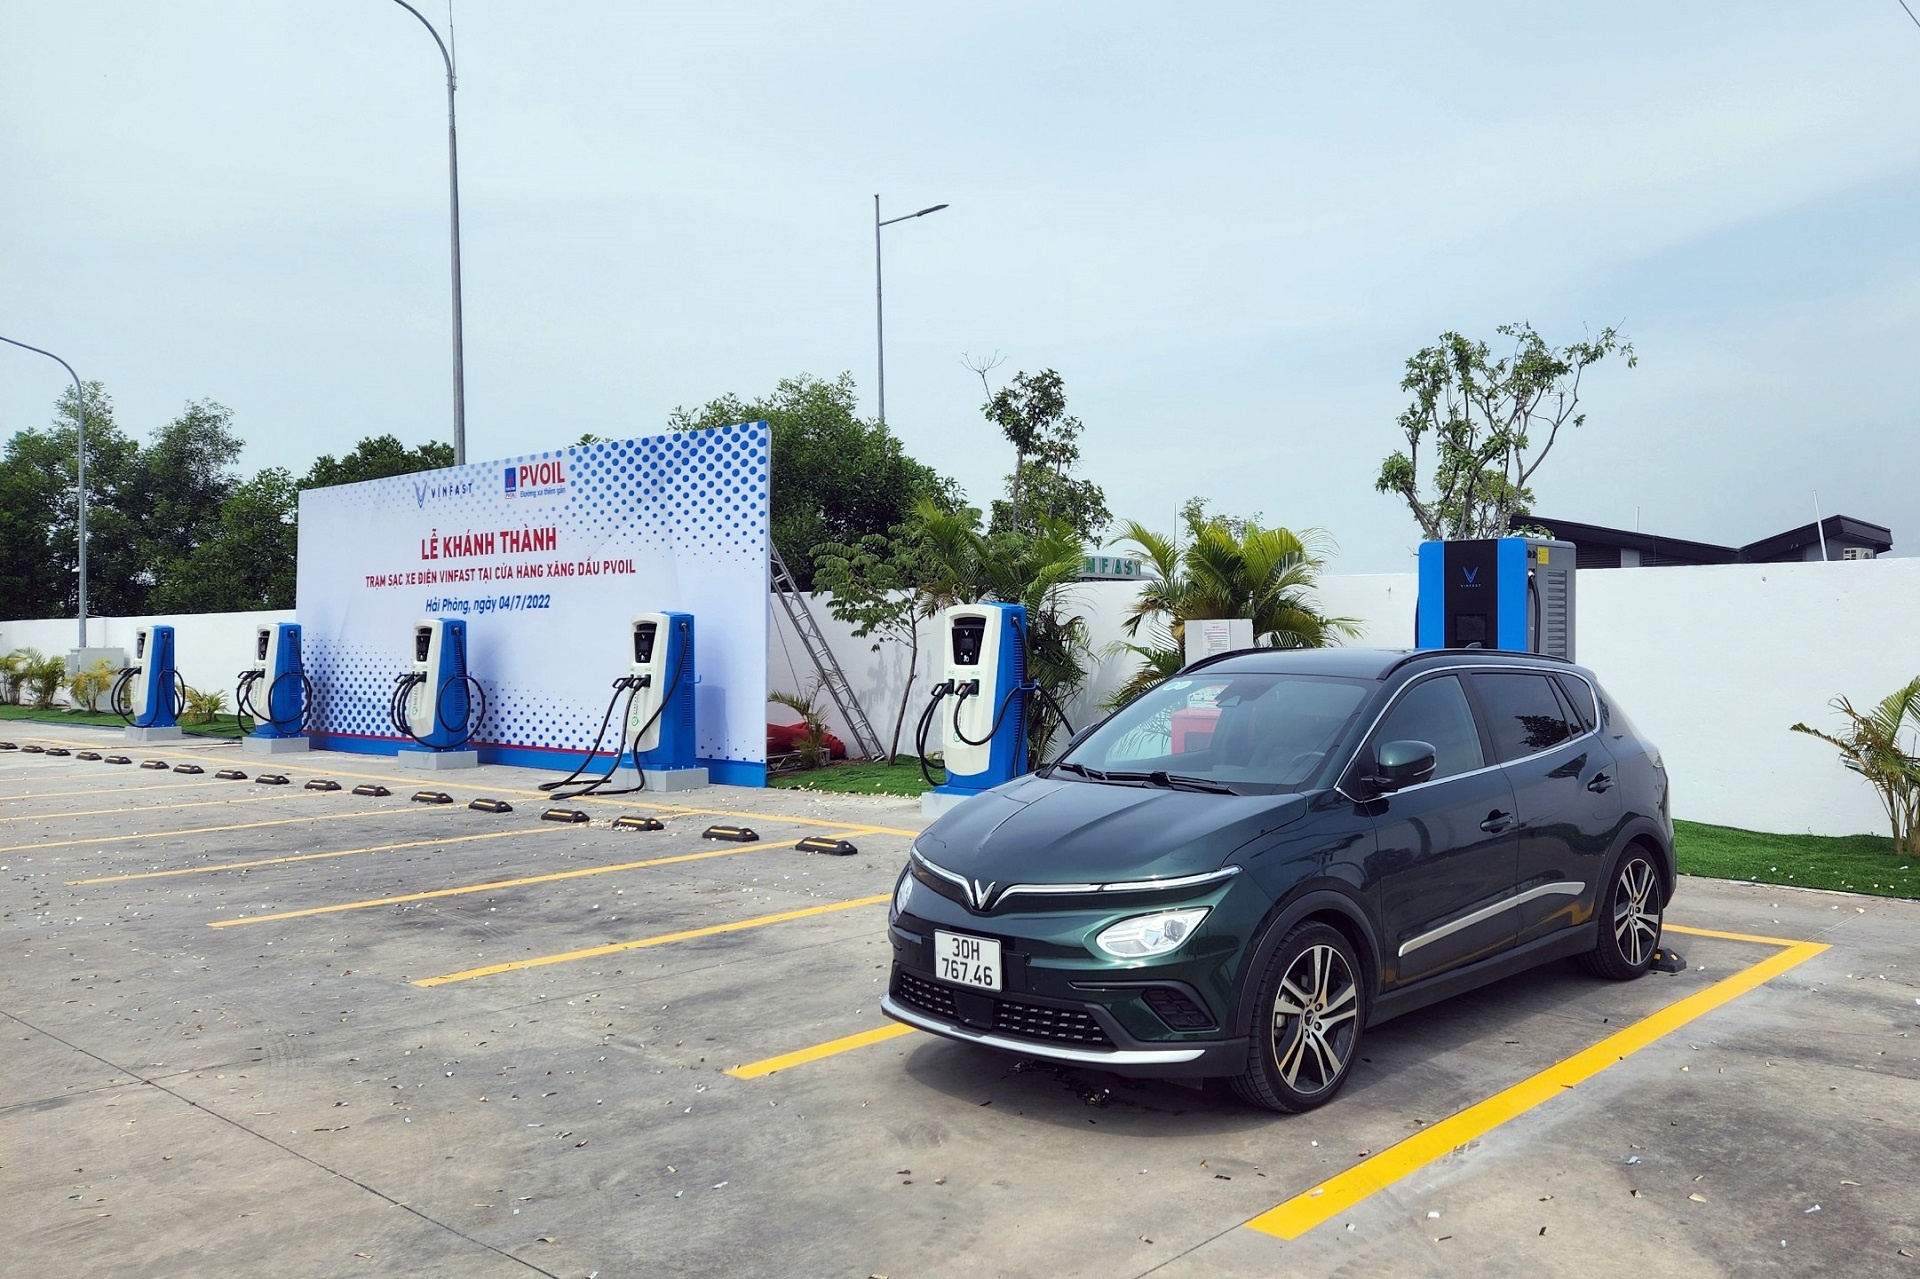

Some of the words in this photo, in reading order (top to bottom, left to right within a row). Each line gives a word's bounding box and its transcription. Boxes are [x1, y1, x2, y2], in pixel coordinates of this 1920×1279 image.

[519, 461, 566, 488] PVOIL
[431, 482, 473, 498] VINFAST
[421, 528, 438, 560] LỄ
[443, 529, 495, 558] KHÁNH
[499, 523, 557, 555] THÀNH
[365, 574, 386, 590] TRẠM
[388, 571, 403, 590] SẠC
[405, 571, 416, 585] XE
[417, 569, 437, 588] ĐIỆN
[439, 567, 475, 583] VINFAST
[477, 566, 492, 584] TẠI
[494, 561, 514, 580] CỬA
[516, 559, 544, 579] HÀNG
[546, 558, 574, 578] XĂNG
[578, 555, 600, 576] DẦU
[603, 559, 636, 575] PVOIL
[425, 595, 440, 613] Hải
[441, 594, 471, 613] Phòng,
[473, 596, 497, 614] ngày
[499, 593, 551, 611] 04/7/2022
[952, 937, 980, 961] 30H
[942, 957, 993, 986] 767.46
